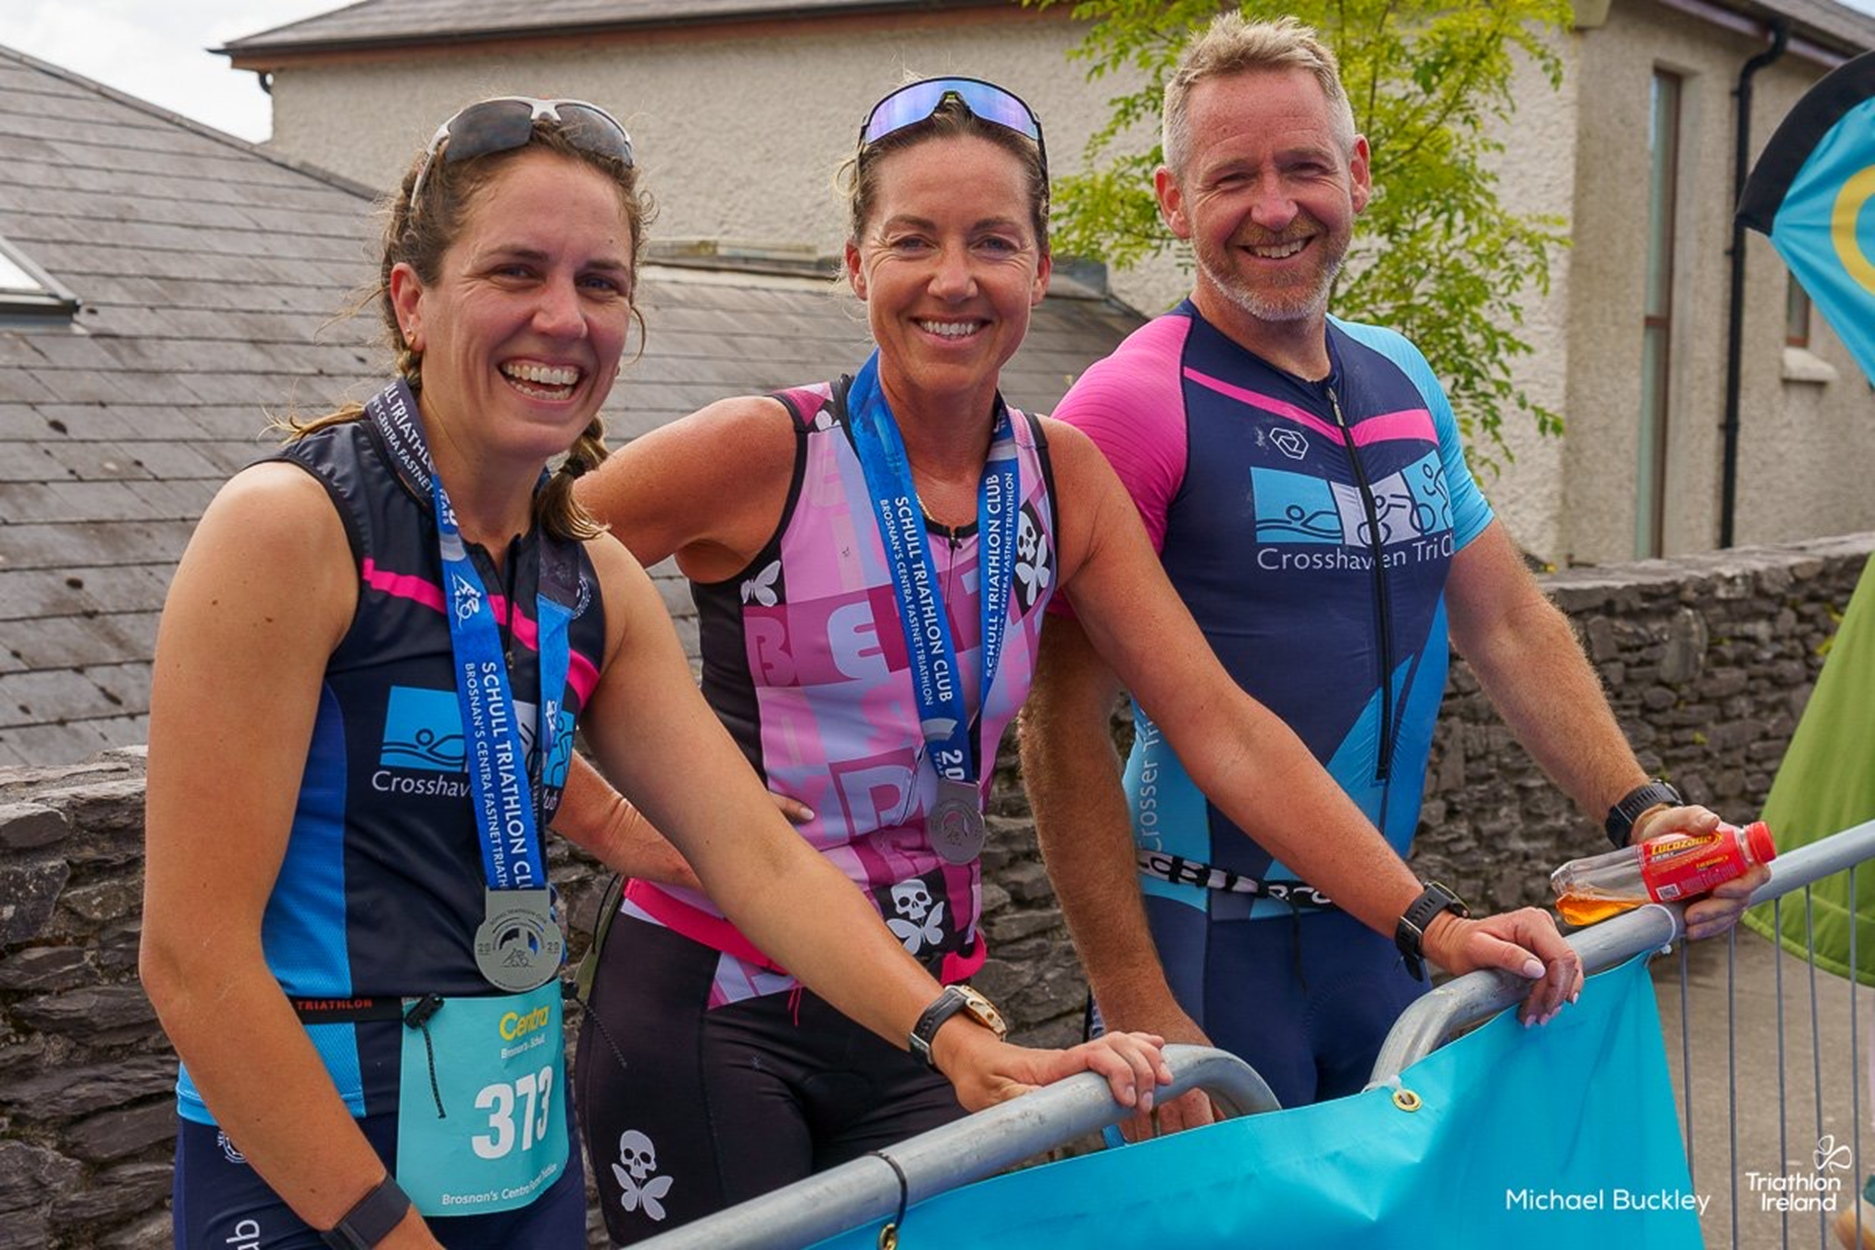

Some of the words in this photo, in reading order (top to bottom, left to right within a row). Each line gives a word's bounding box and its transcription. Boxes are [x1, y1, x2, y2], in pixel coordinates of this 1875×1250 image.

[377, 411, 400, 451] CENTRA
[398, 449, 433, 492] FASTNET
[986, 475, 1001, 514] CLUB
[1004, 472, 1014, 528] TRIATHLON
[987, 520, 1001, 611] TRIATHLON
[1412, 540, 1438, 562] Tri
[880, 499, 904, 563] BROSNAN'S
[896, 561, 914, 604] CENTRA
[906, 605, 924, 649] FASTNET
[917, 648, 934, 706] TRIATHLON
[895, 496, 918, 559] SCHULL
[911, 560, 946, 657] TRIATHLON
[933, 658, 953, 702] CLUB
[986, 616, 999, 677] SCHULL
[465, 663, 486, 738] BROSNAN'S
[476, 741, 493, 790] CENTRA
[482, 662, 507, 737] SCHULL
[495, 741, 528, 854] TRIATHLON
[942, 749, 965, 780] 20
[483, 793, 502, 845] FASTNET
[1138, 759, 1162, 852] Crosser
[500, 1006, 550, 1040] Centra
[472, 1066, 553, 1159] 373
[442, 1190, 499, 1206] Brosnan's
[501, 1184, 530, 1200] Centra
